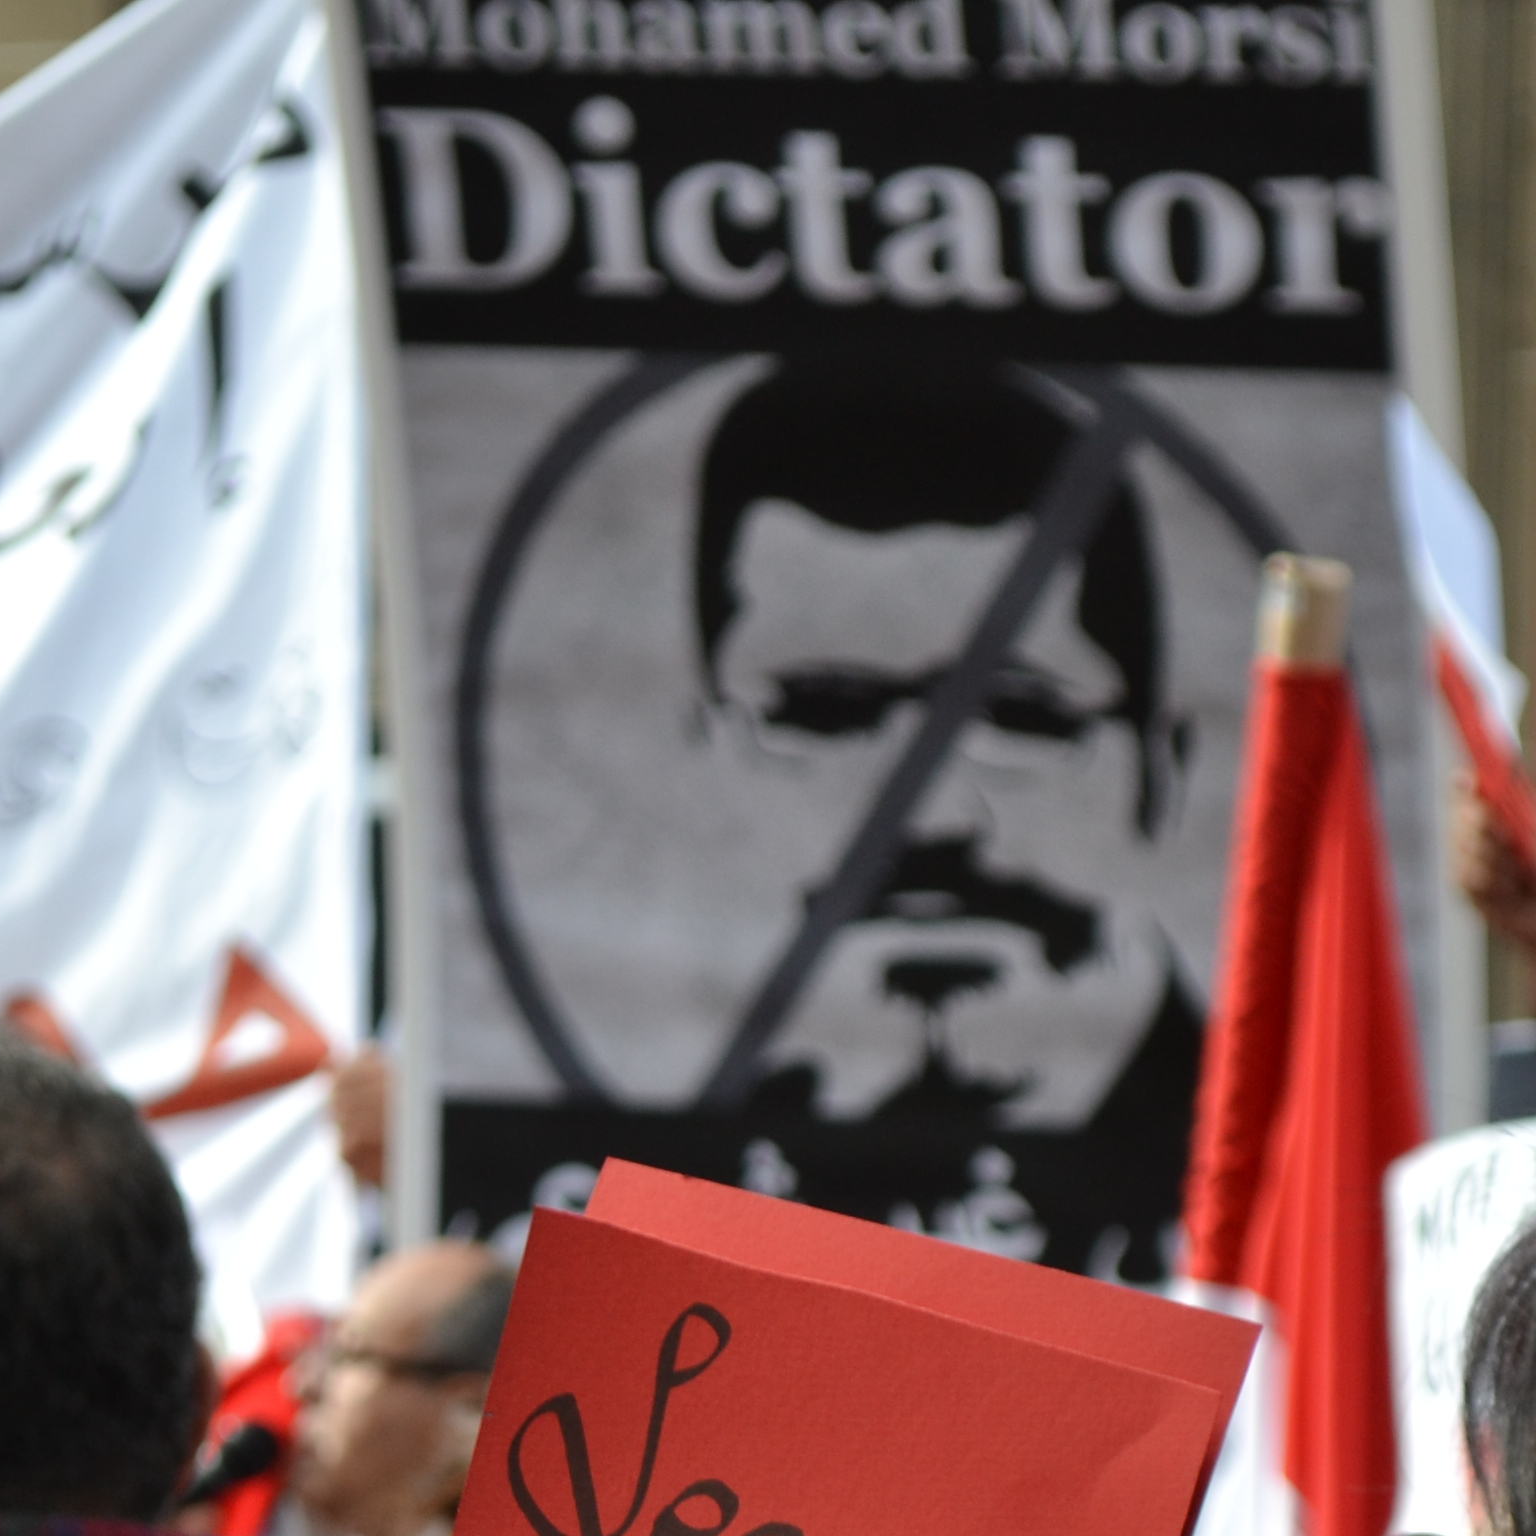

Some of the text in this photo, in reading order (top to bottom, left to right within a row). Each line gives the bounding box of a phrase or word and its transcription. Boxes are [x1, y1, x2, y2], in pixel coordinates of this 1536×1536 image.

[364, 0, 1372, 83] Mohamed Morsi
[376, 94, 1392, 315] Dictator
